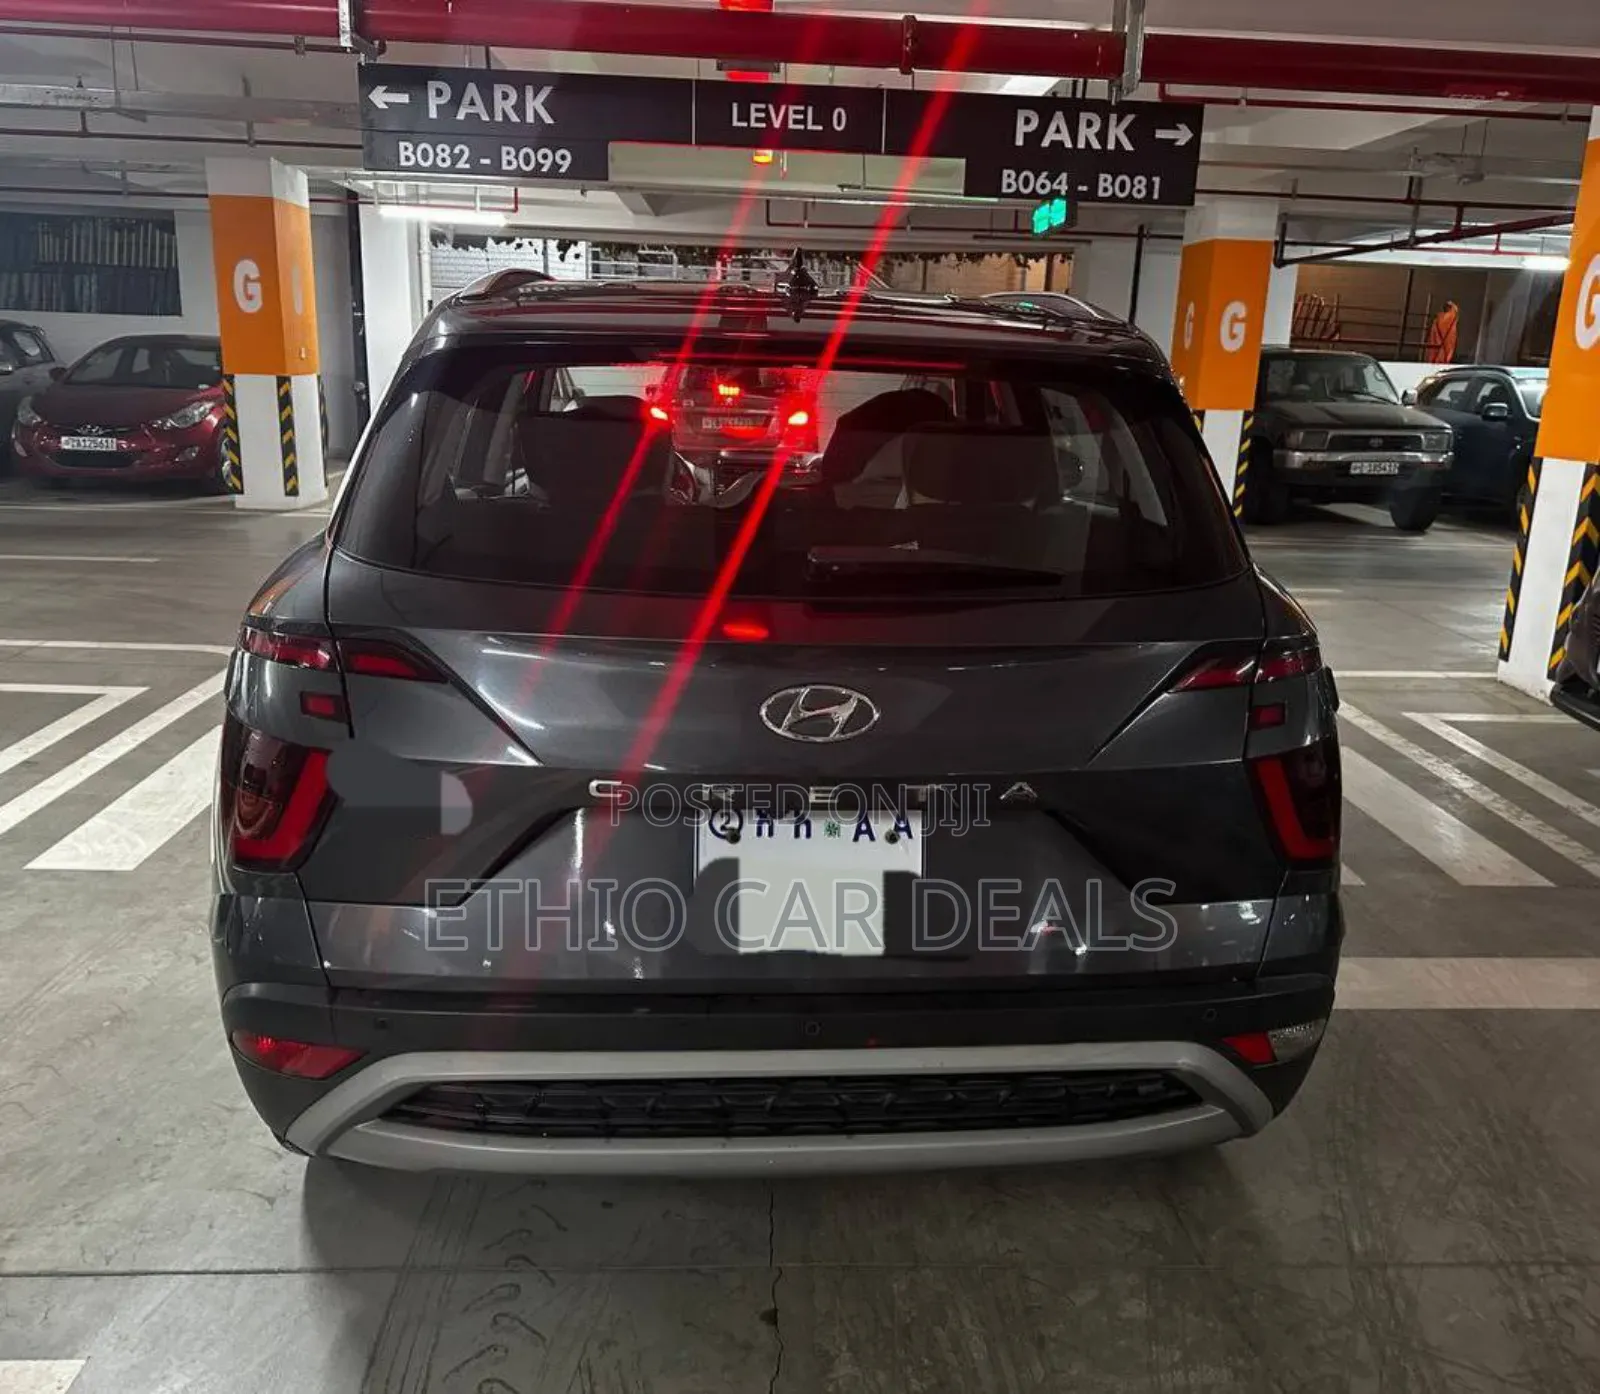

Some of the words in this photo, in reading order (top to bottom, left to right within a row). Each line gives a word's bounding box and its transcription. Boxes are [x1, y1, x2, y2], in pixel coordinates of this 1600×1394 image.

[427, 80, 556, 125] PARK
[732, 102, 823, 132] LEVEL
[832, 107, 847, 132] 0
[1015, 108, 1135, 152] PARK
[399, 141, 471, 169] B082
[501, 145, 573, 174] B099
[1000, 169, 1069, 197] B064
[1097, 172, 1162, 200] B081
[233, 258, 264, 314] G
[1575, 252, 1600, 350] G
[1220, 300, 1247, 353] G
